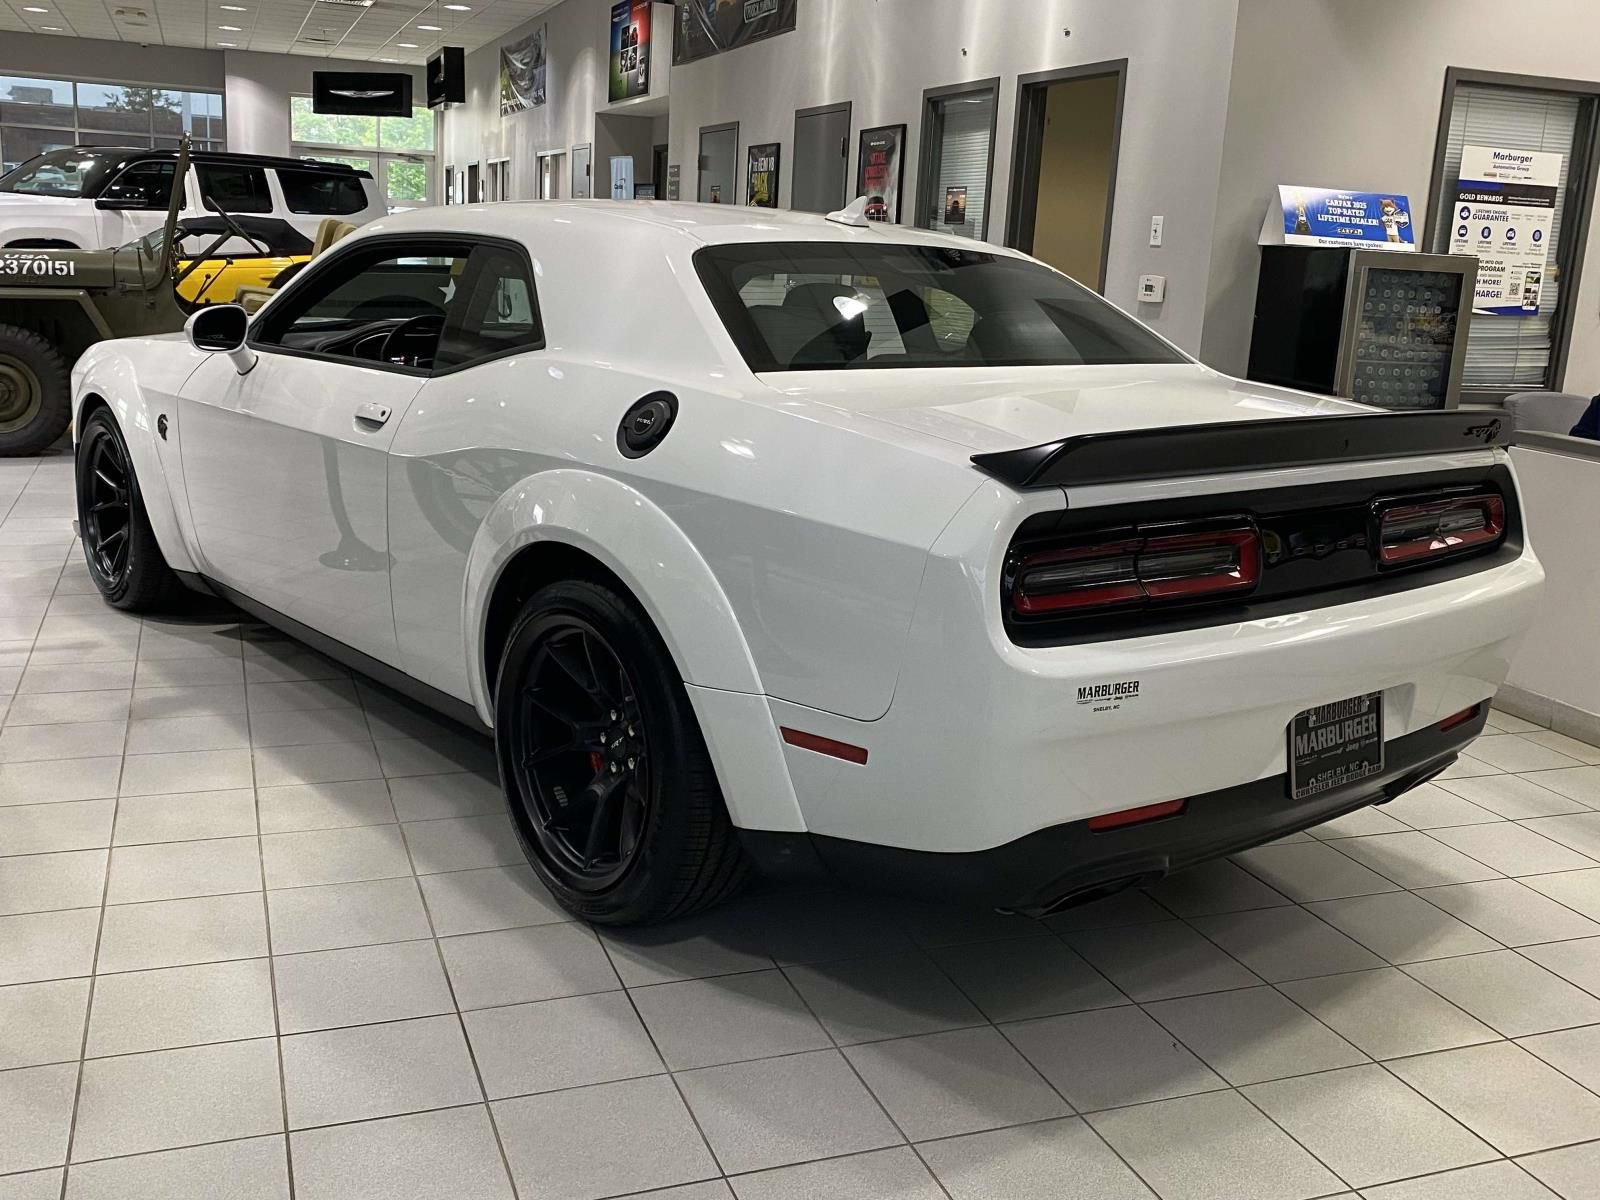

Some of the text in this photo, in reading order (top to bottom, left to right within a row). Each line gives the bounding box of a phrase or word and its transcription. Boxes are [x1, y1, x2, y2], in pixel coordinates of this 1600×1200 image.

[1493, 152, 1533, 163] Marburger
[1459, 193, 1476, 201] GOLD
[1476, 194, 1503, 203] REWARDS
[1326, 199, 1367, 209] CARFAX 2025
[1328, 206, 1365, 217] TOP-RATED
[1318, 214, 1380, 226] LIFETIME DEALER!
[1472, 213, 1509, 222] GUARANTEE
[1478, 265, 1506, 273] PROGRAM
[1475, 290, 1502, 299] HARGE!
[1077, 680, 1140, 700] MARBURGER
[1296, 713, 1377, 757] MARBURGER
[1349, 761, 1360, 771] NC
